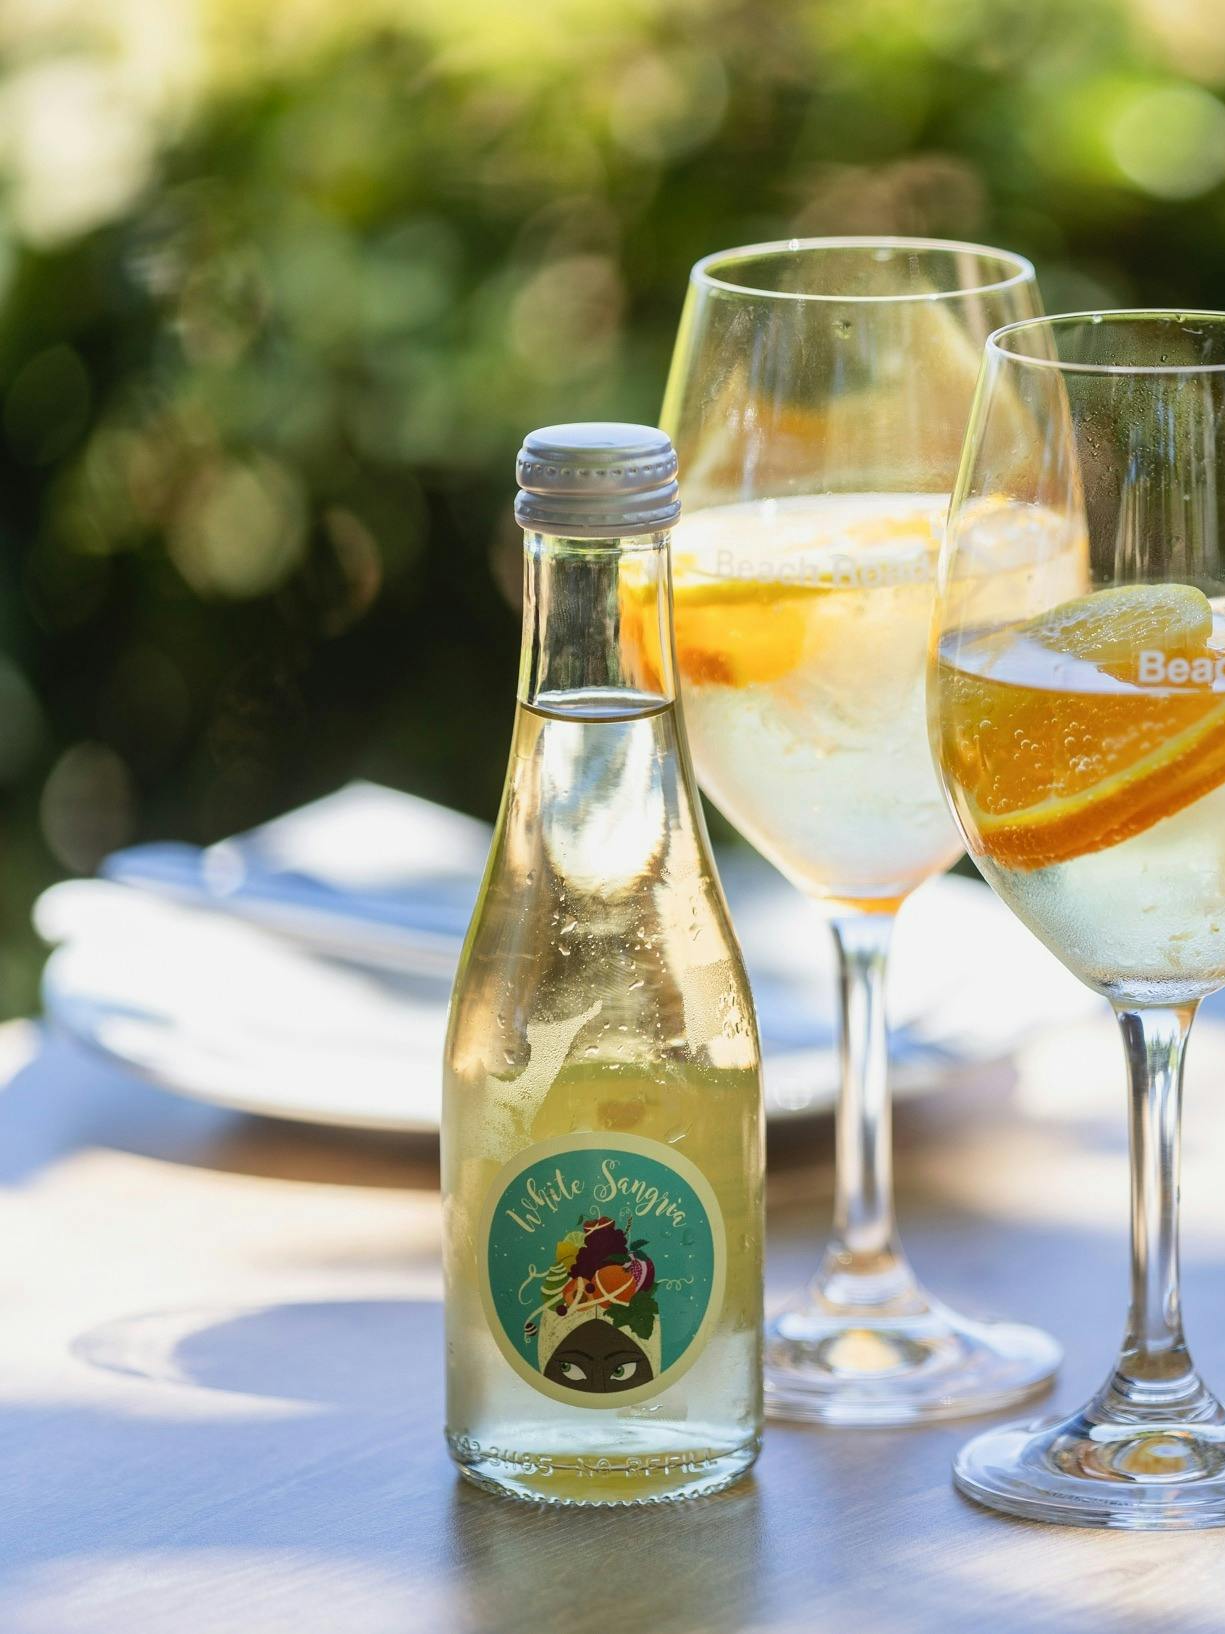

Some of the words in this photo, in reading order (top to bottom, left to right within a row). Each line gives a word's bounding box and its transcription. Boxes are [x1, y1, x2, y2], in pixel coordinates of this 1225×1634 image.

[716, 549, 818, 584] Beach
[506, 1169, 584, 1234] White
[593, 1158, 687, 1229] Sangria
